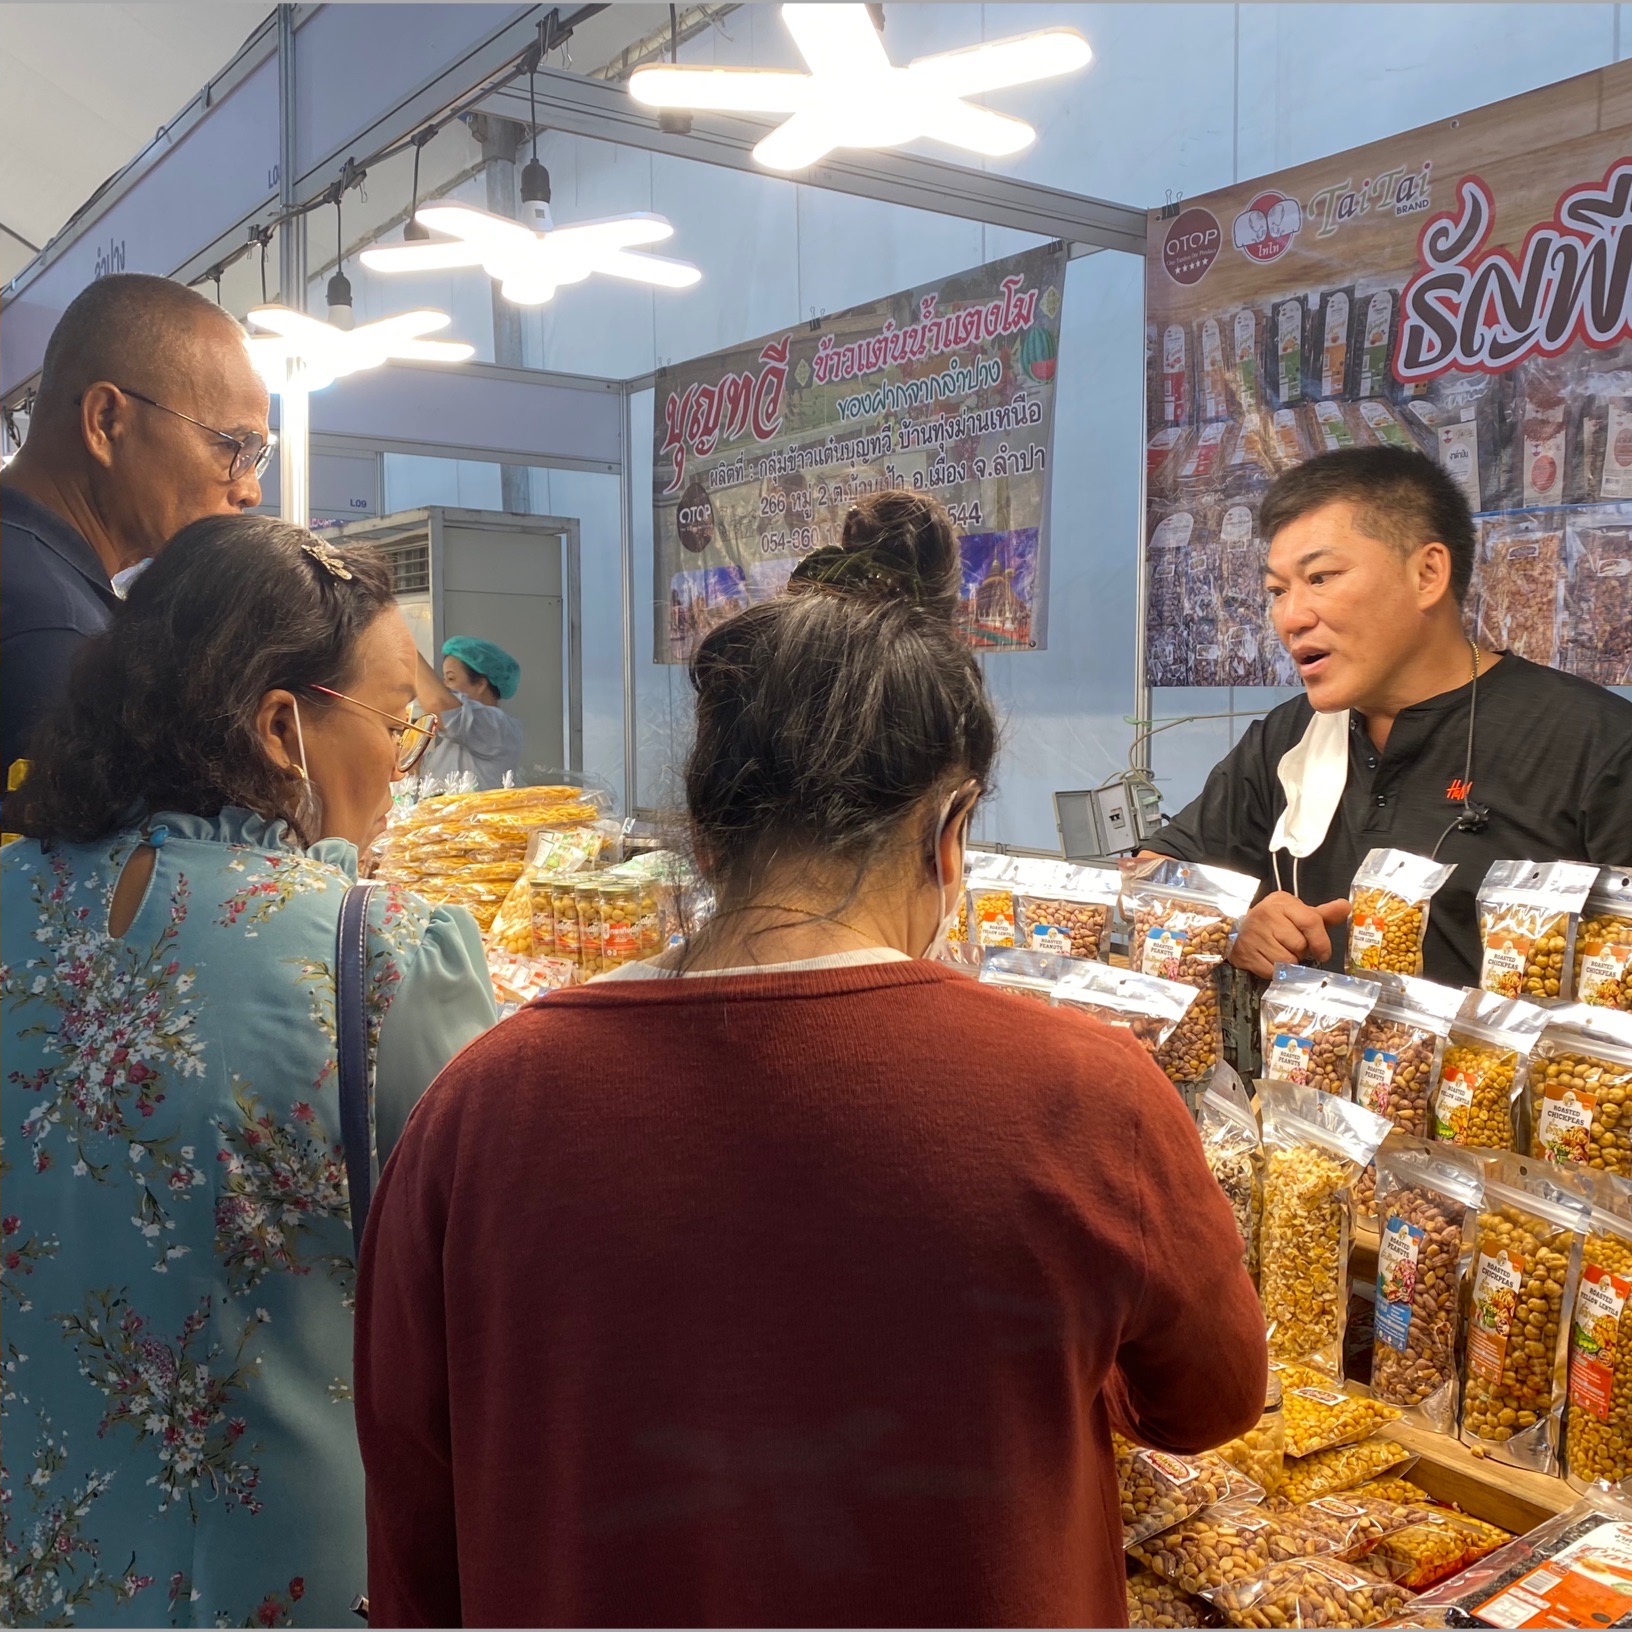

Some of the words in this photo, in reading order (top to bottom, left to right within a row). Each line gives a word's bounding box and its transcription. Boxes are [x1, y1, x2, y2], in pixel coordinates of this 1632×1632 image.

[268, 164, 279, 189] L0
[1395, 199, 1430, 216] BRAND
[1166, 229, 1218, 256] OTOP
[813, 273, 1038, 385] ข้าวแต๋นน้ำแตงโม
[836, 356, 1002, 422] ของฝากจากลำปาง
[661, 334, 793, 494] บุญทวี
[709, 451, 745, 488] ผลิตที่
[899, 392, 1042, 453] บ้านทุ่งม่านเหนือ
[760, 493, 787, 517] 266
[791, 482, 813, 521] หมู่
[818, 486, 828, 507] 2
[913, 453, 967, 490] อ.เมือง
[974, 442, 1046, 482] จ.ลำปา
[349, 498, 367, 508] L09
[679, 504, 712, 525] OTOP
[1150, 947, 1174, 957] PEANUTS
[1152, 942, 1174, 951] ROASTED
[1487, 958, 1519, 970] CHICKPEAS
[1493, 954, 1517, 963] ROASTED
[1590, 960, 1614, 970] ROASTED
[1585, 966, 1616, 978] CHICKPEAS
[1278, 1056, 1301, 1067] PEANUTS
[1280, 1051, 1301, 1061] ROASTED
[1365, 1070, 1385, 1082] PEANUTS
[1367, 1065, 1386, 1076] ROASTED
[1547, 1110, 1585, 1126] CHICKPEAS
[1553, 1104, 1581, 1118] ROASTED
[1387, 1241, 1410, 1259] PEANUTS
[1390, 1236, 1410, 1251] ROASTED
[1486, 1261, 1511, 1278] ROASTED
[1481, 1267, 1514, 1289] CHICKPEAS
[1589, 1287, 1614, 1305] ROASTED
